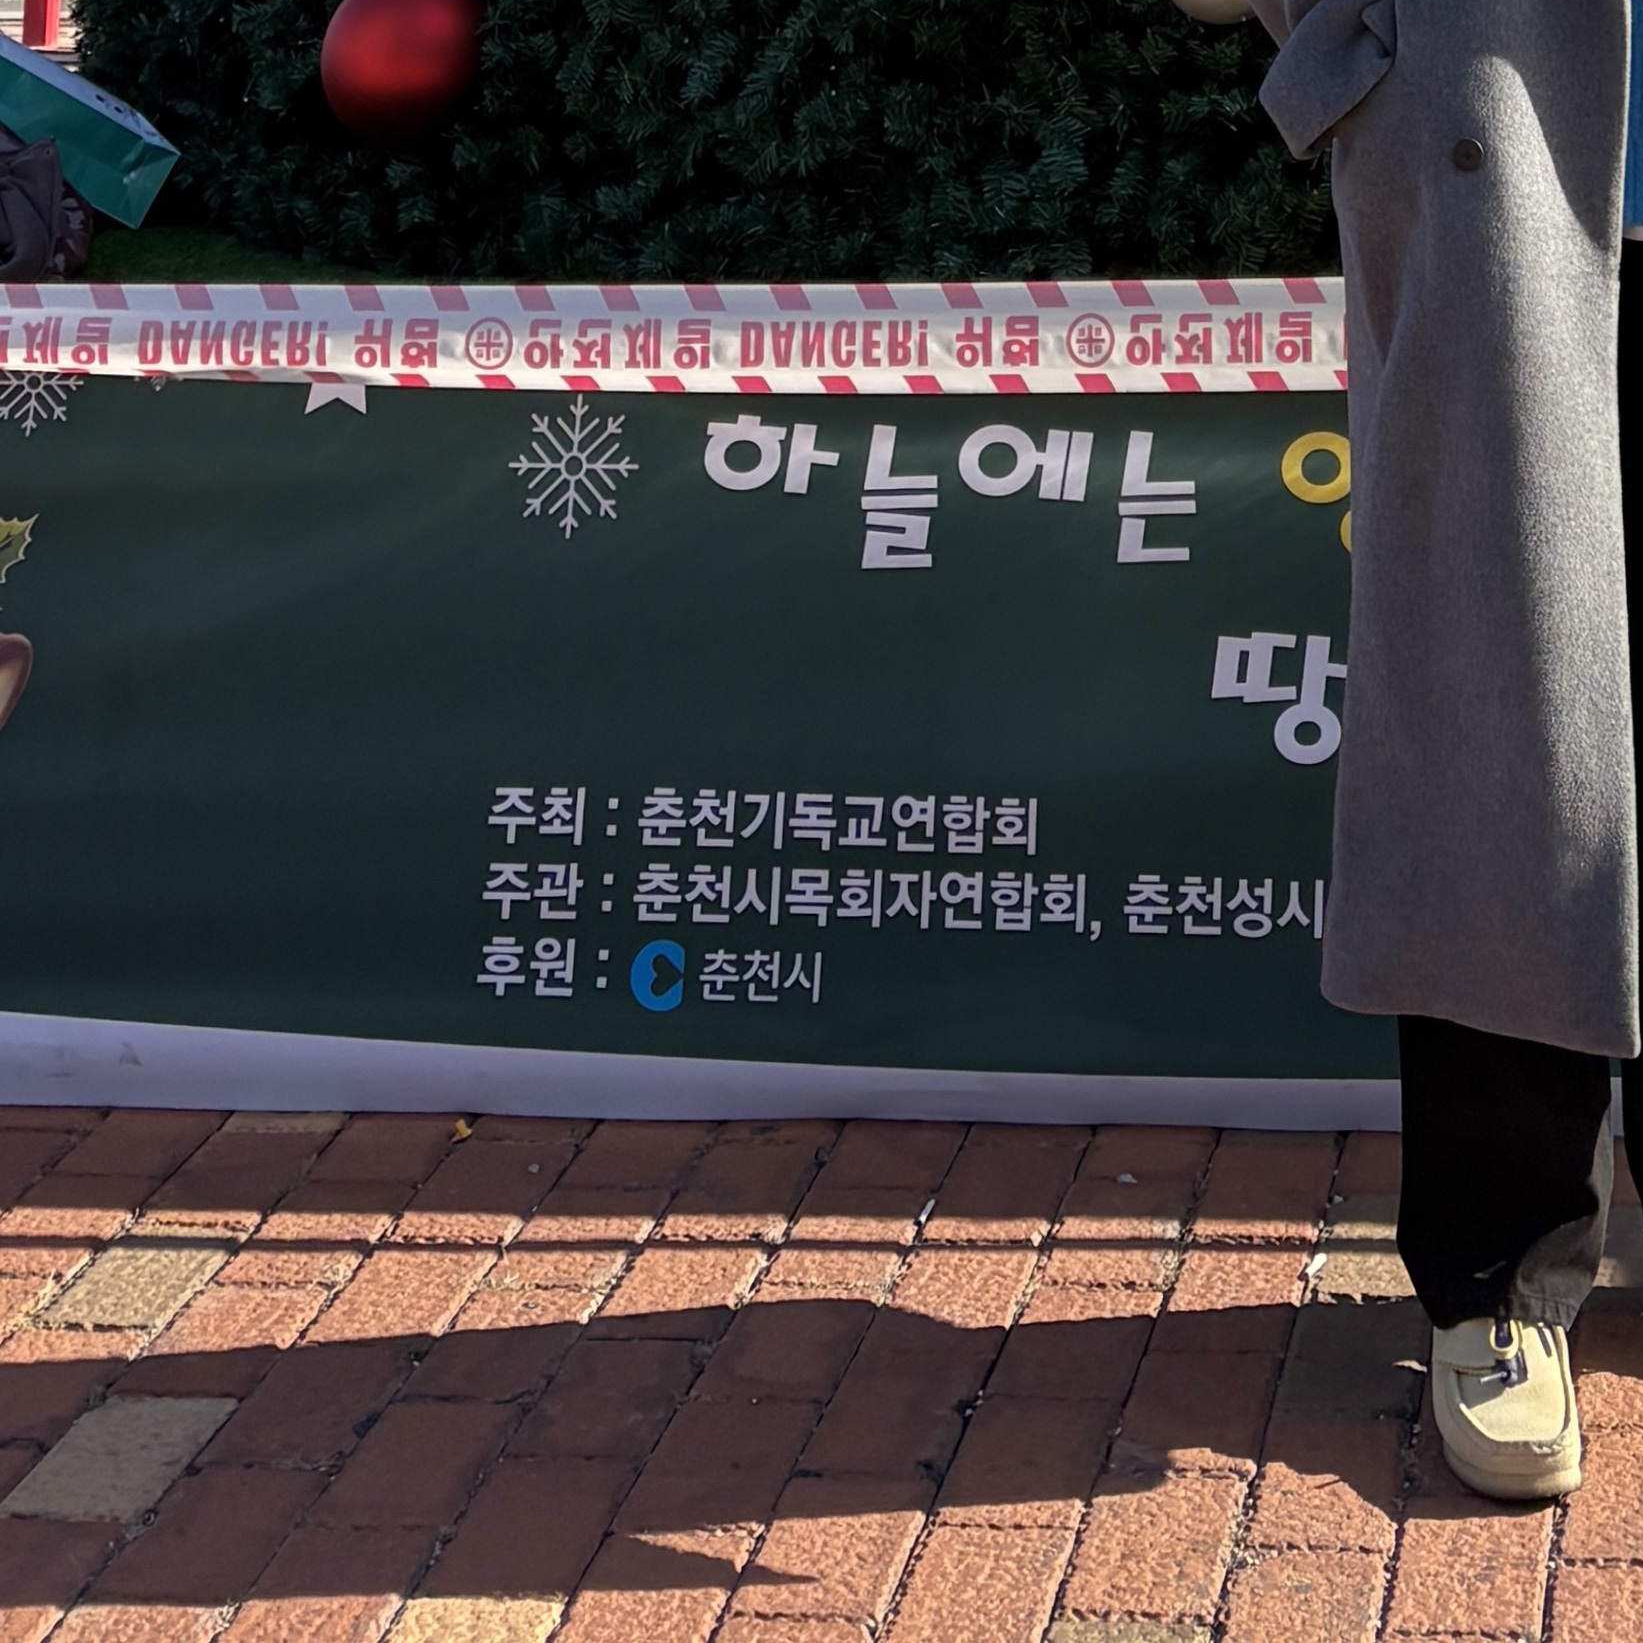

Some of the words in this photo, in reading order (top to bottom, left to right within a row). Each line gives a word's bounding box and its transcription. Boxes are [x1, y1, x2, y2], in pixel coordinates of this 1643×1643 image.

[703, 413, 1197, 569] 하늘에는
[1211, 631, 1349, 765] 땅
[487, 786, 587, 846] 주최
[636, 786, 1039, 856] 춘천기독교연합회
[481, 861, 584, 921] 주관
[632, 862, 1102, 943] 춘천시목회자연합회,
[1123, 874, 1325, 939] 춘천성시
[475, 935, 576, 998] 후원
[699, 948, 824, 1004] 춘천시
